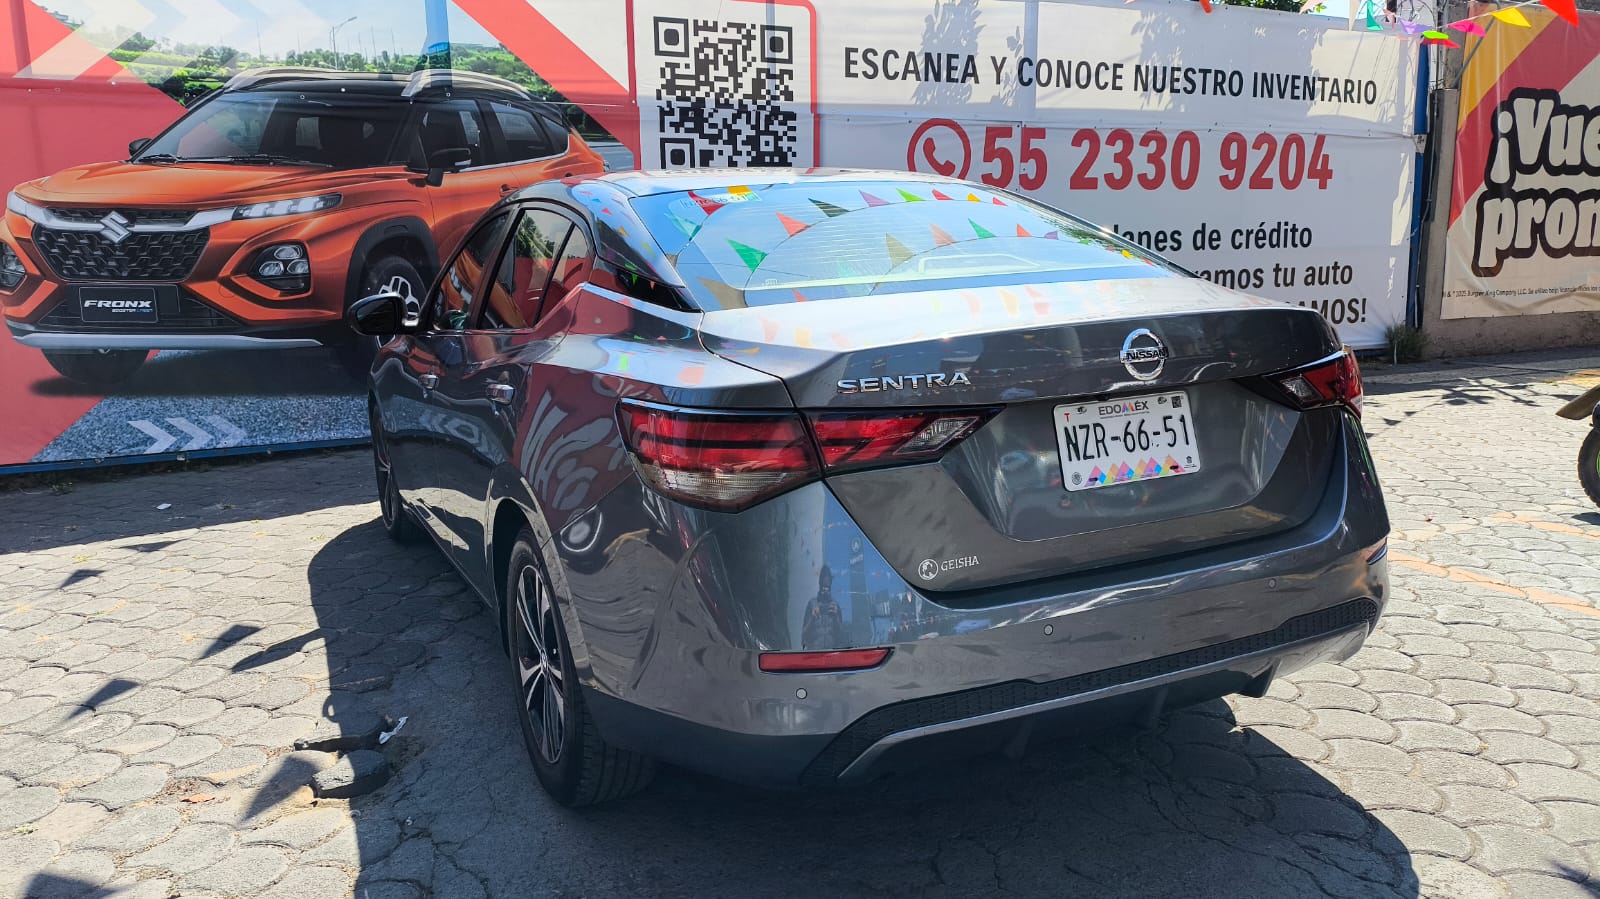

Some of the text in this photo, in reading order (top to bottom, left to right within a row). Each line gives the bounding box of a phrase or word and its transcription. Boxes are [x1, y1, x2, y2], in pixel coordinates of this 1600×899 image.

[844, 46, 1377, 105] ESCANEA Y CONOCE NUESTRO INVENTARIO
[981, 126, 1333, 191] 55 2330 9204
[1192, 222, 1222, 251] de
[1230, 221, 1313, 250] crédito
[1272, 262, 1296, 288] tu
[1303, 260, 1353, 286] auto
[83, 299, 153, 308] FRONX
[1126, 347, 1169, 360] NISSAN
[836, 372, 972, 395] SENTRA
[1064, 414, 1190, 462] NZR-66-51
[940, 555, 980, 571] GEISHA
